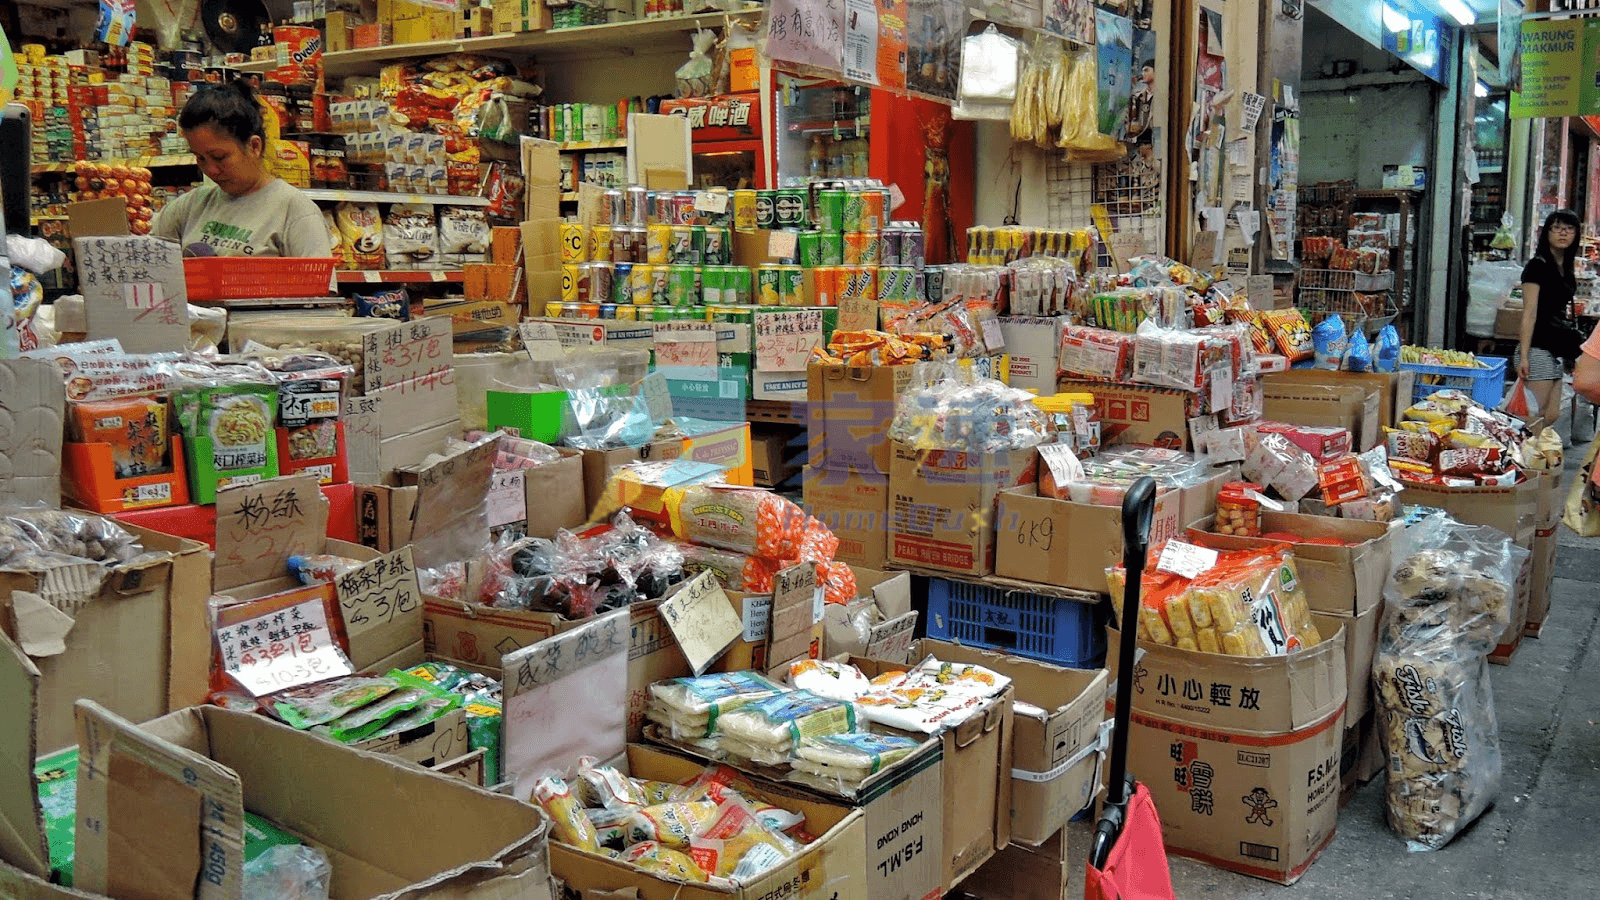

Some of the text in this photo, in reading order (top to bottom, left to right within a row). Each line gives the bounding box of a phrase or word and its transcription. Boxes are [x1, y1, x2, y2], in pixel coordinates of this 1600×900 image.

[1522, 30, 1575, 42] WARUNG
[200, 234, 254, 256] RACING
[879, 271, 899, 301] Sunkist
[233, 487, 304, 530] 粉絲
[692, 504, 745, 525] RICE STICK
[897, 544, 919, 557] PEARL
[942, 552, 970, 565] BRIDGE
[750, 610, 765, 618] Hero
[1156, 673, 1261, 712] 小心輕放
[1395, 664, 1430, 715] Fish
[1445, 708, 1467, 758] Fish
[1171, 743, 1188, 786] 旺旺
[1189, 761, 1215, 816] 雪餅
[877, 811, 923, 850] HONG KONG
[877, 835, 923, 878] F.S.M.L.
